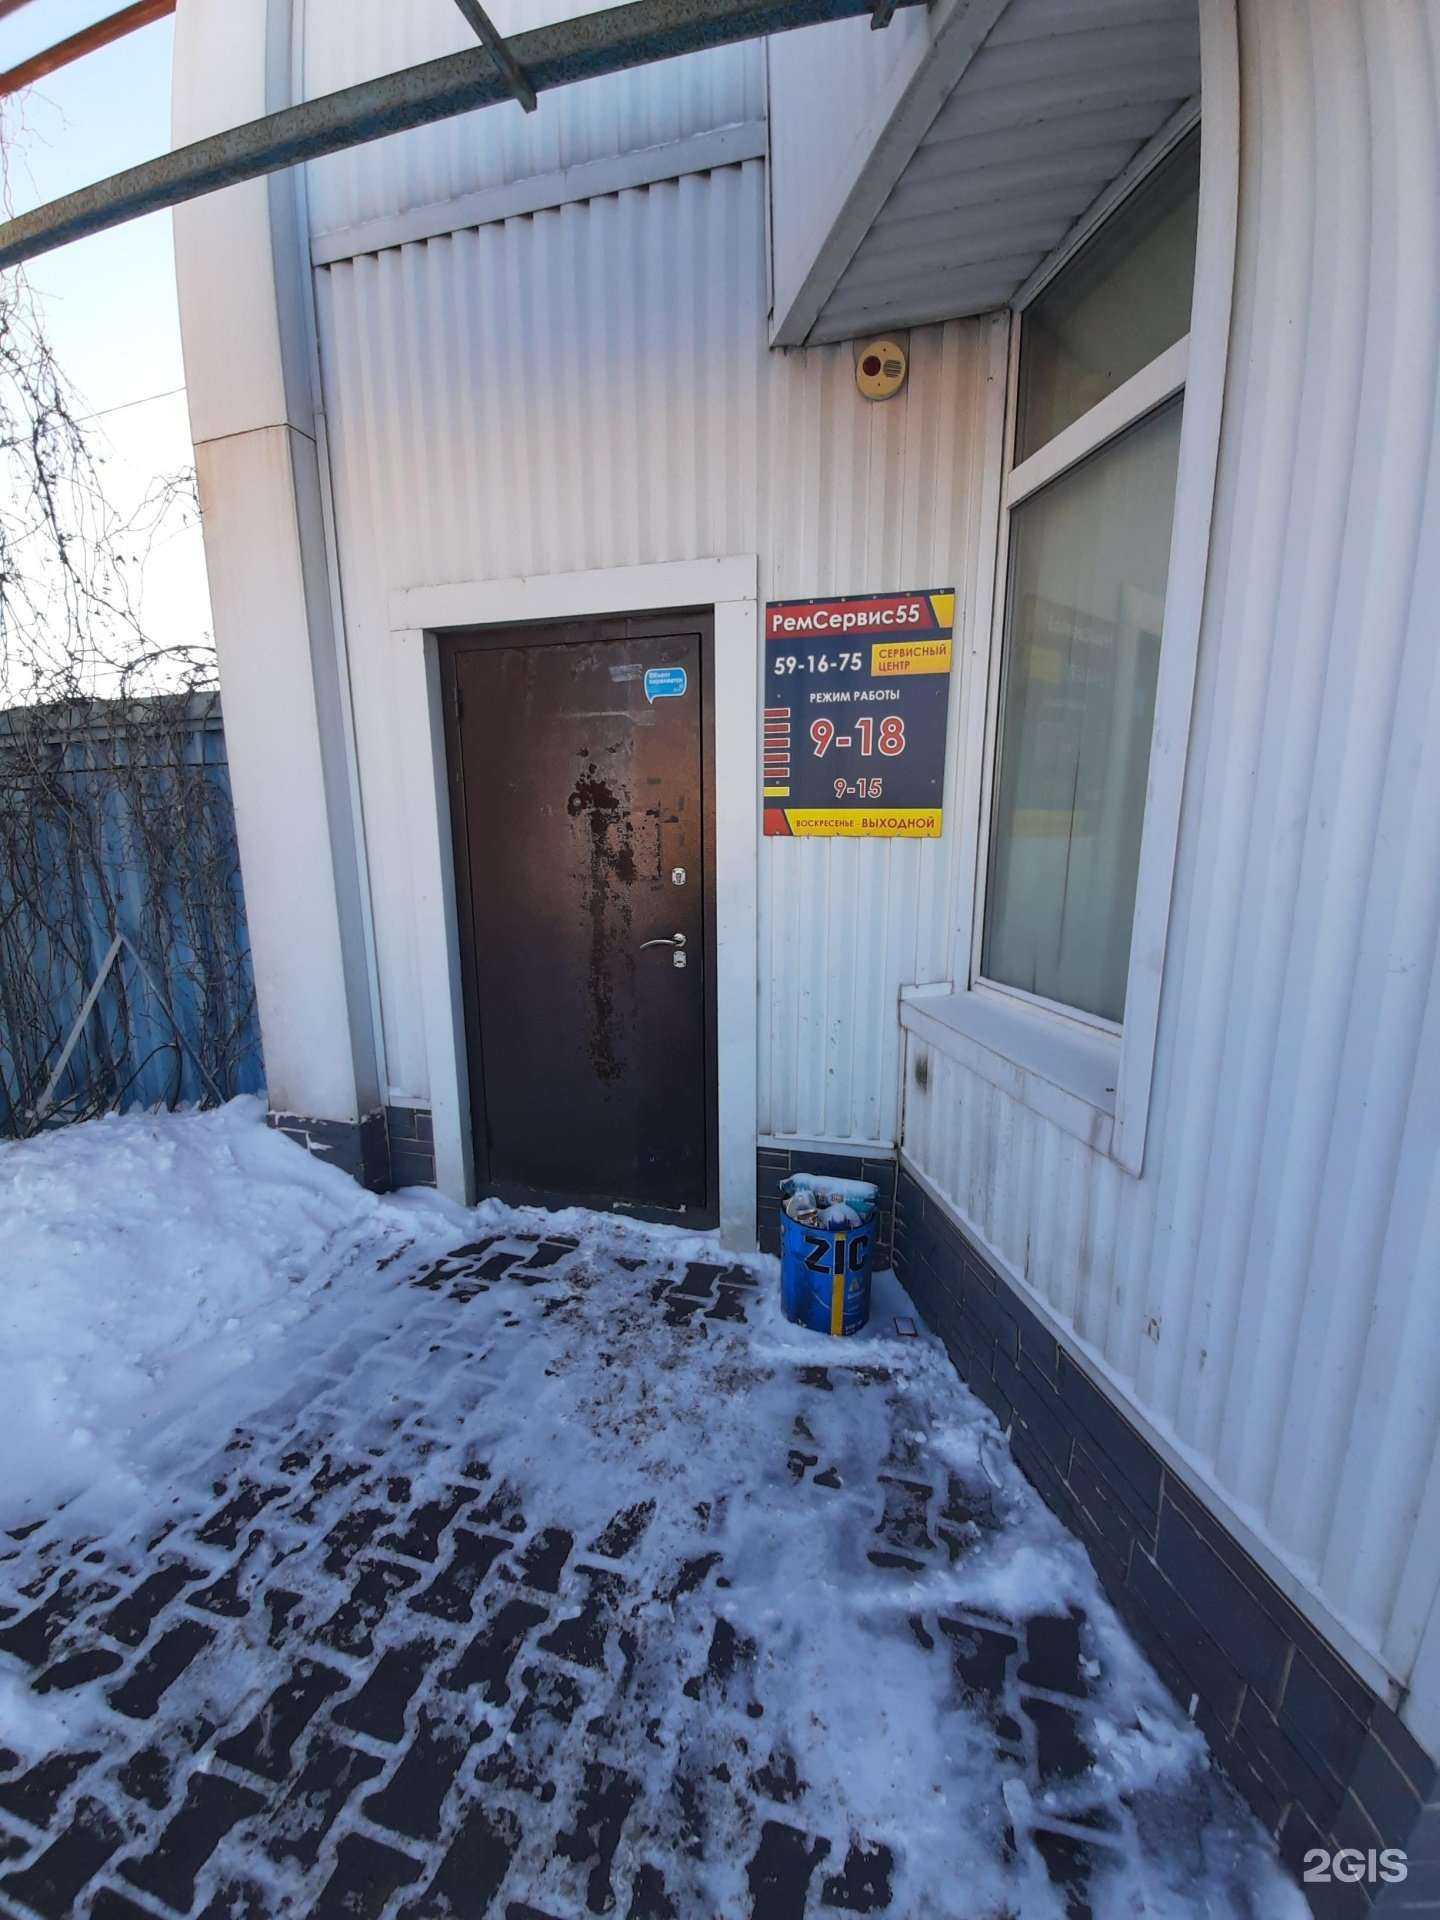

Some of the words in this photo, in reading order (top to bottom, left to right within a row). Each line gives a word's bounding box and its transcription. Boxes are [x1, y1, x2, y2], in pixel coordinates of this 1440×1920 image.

[772, 604, 920, 632] РемСервис55
[879, 644, 947, 659] СЕРВИСНЫЙ
[774, 652, 863, 675] 59-16-75
[878, 660, 911, 672] ЦЕНТР
[809, 692, 851, 703] РЕЖИМ
[853, 690, 900, 701] РАБОТЫ
[809, 715, 906, 758] 9-18
[833, 778, 883, 798] 9-15
[861, 815, 935, 829] ВЫХОДНОЙ
[804, 1235, 870, 1275] ZIC
